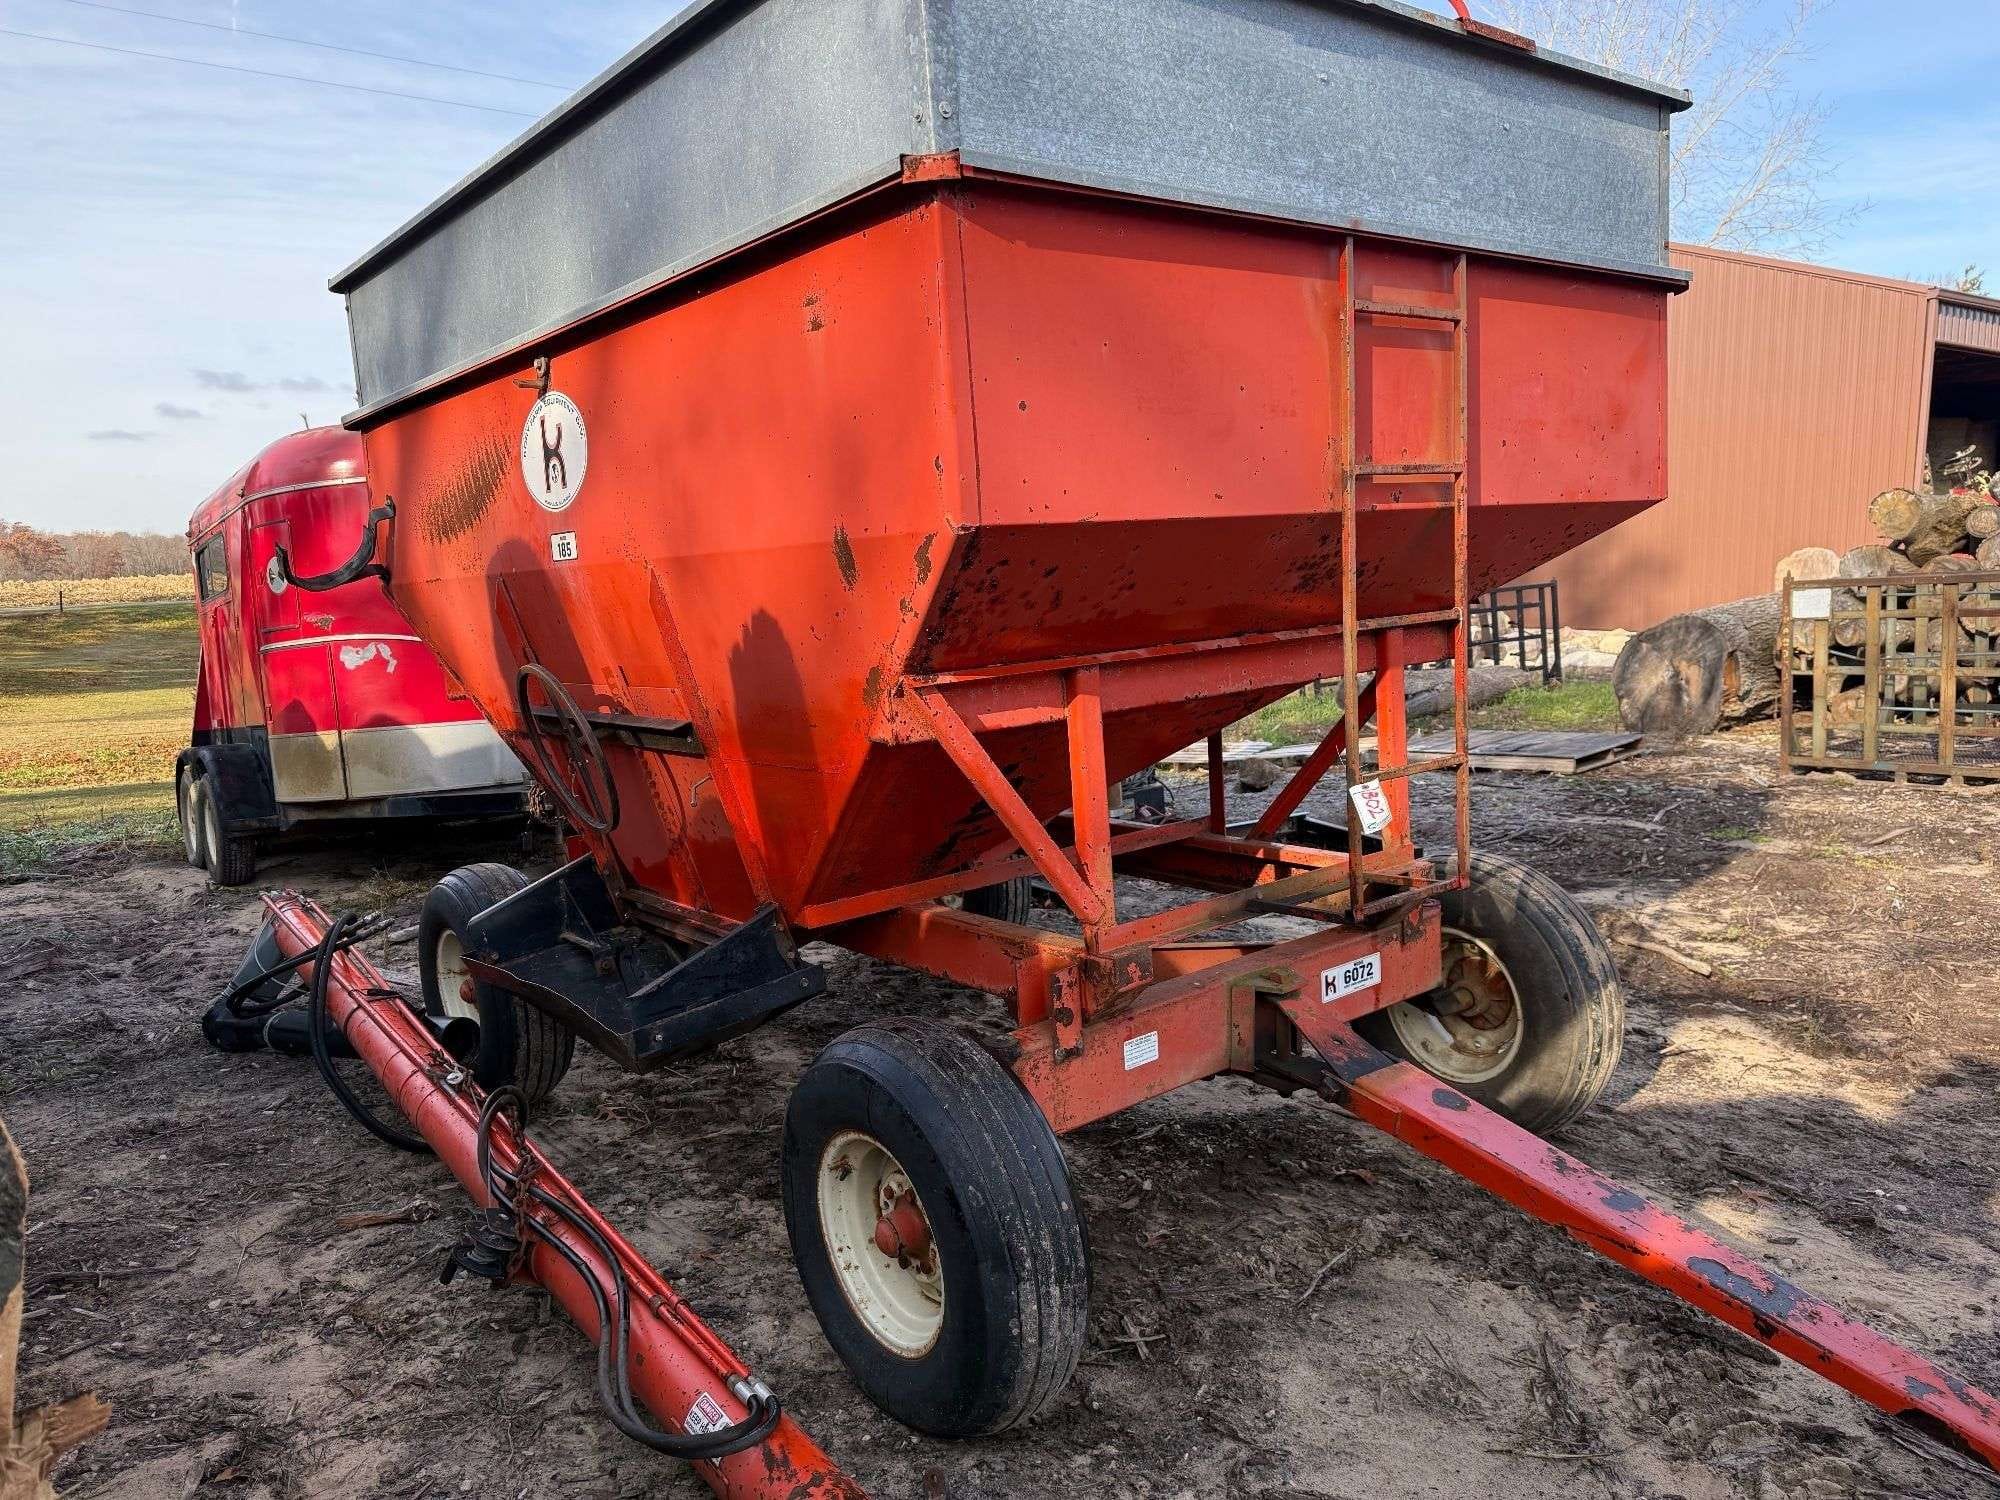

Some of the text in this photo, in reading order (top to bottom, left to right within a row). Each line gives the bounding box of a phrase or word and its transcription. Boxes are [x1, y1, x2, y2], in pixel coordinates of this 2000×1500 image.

[557, 541, 572, 559] 185
[1343, 961, 1374, 985] 6072
[700, 1400, 719, 1423] DANGER
